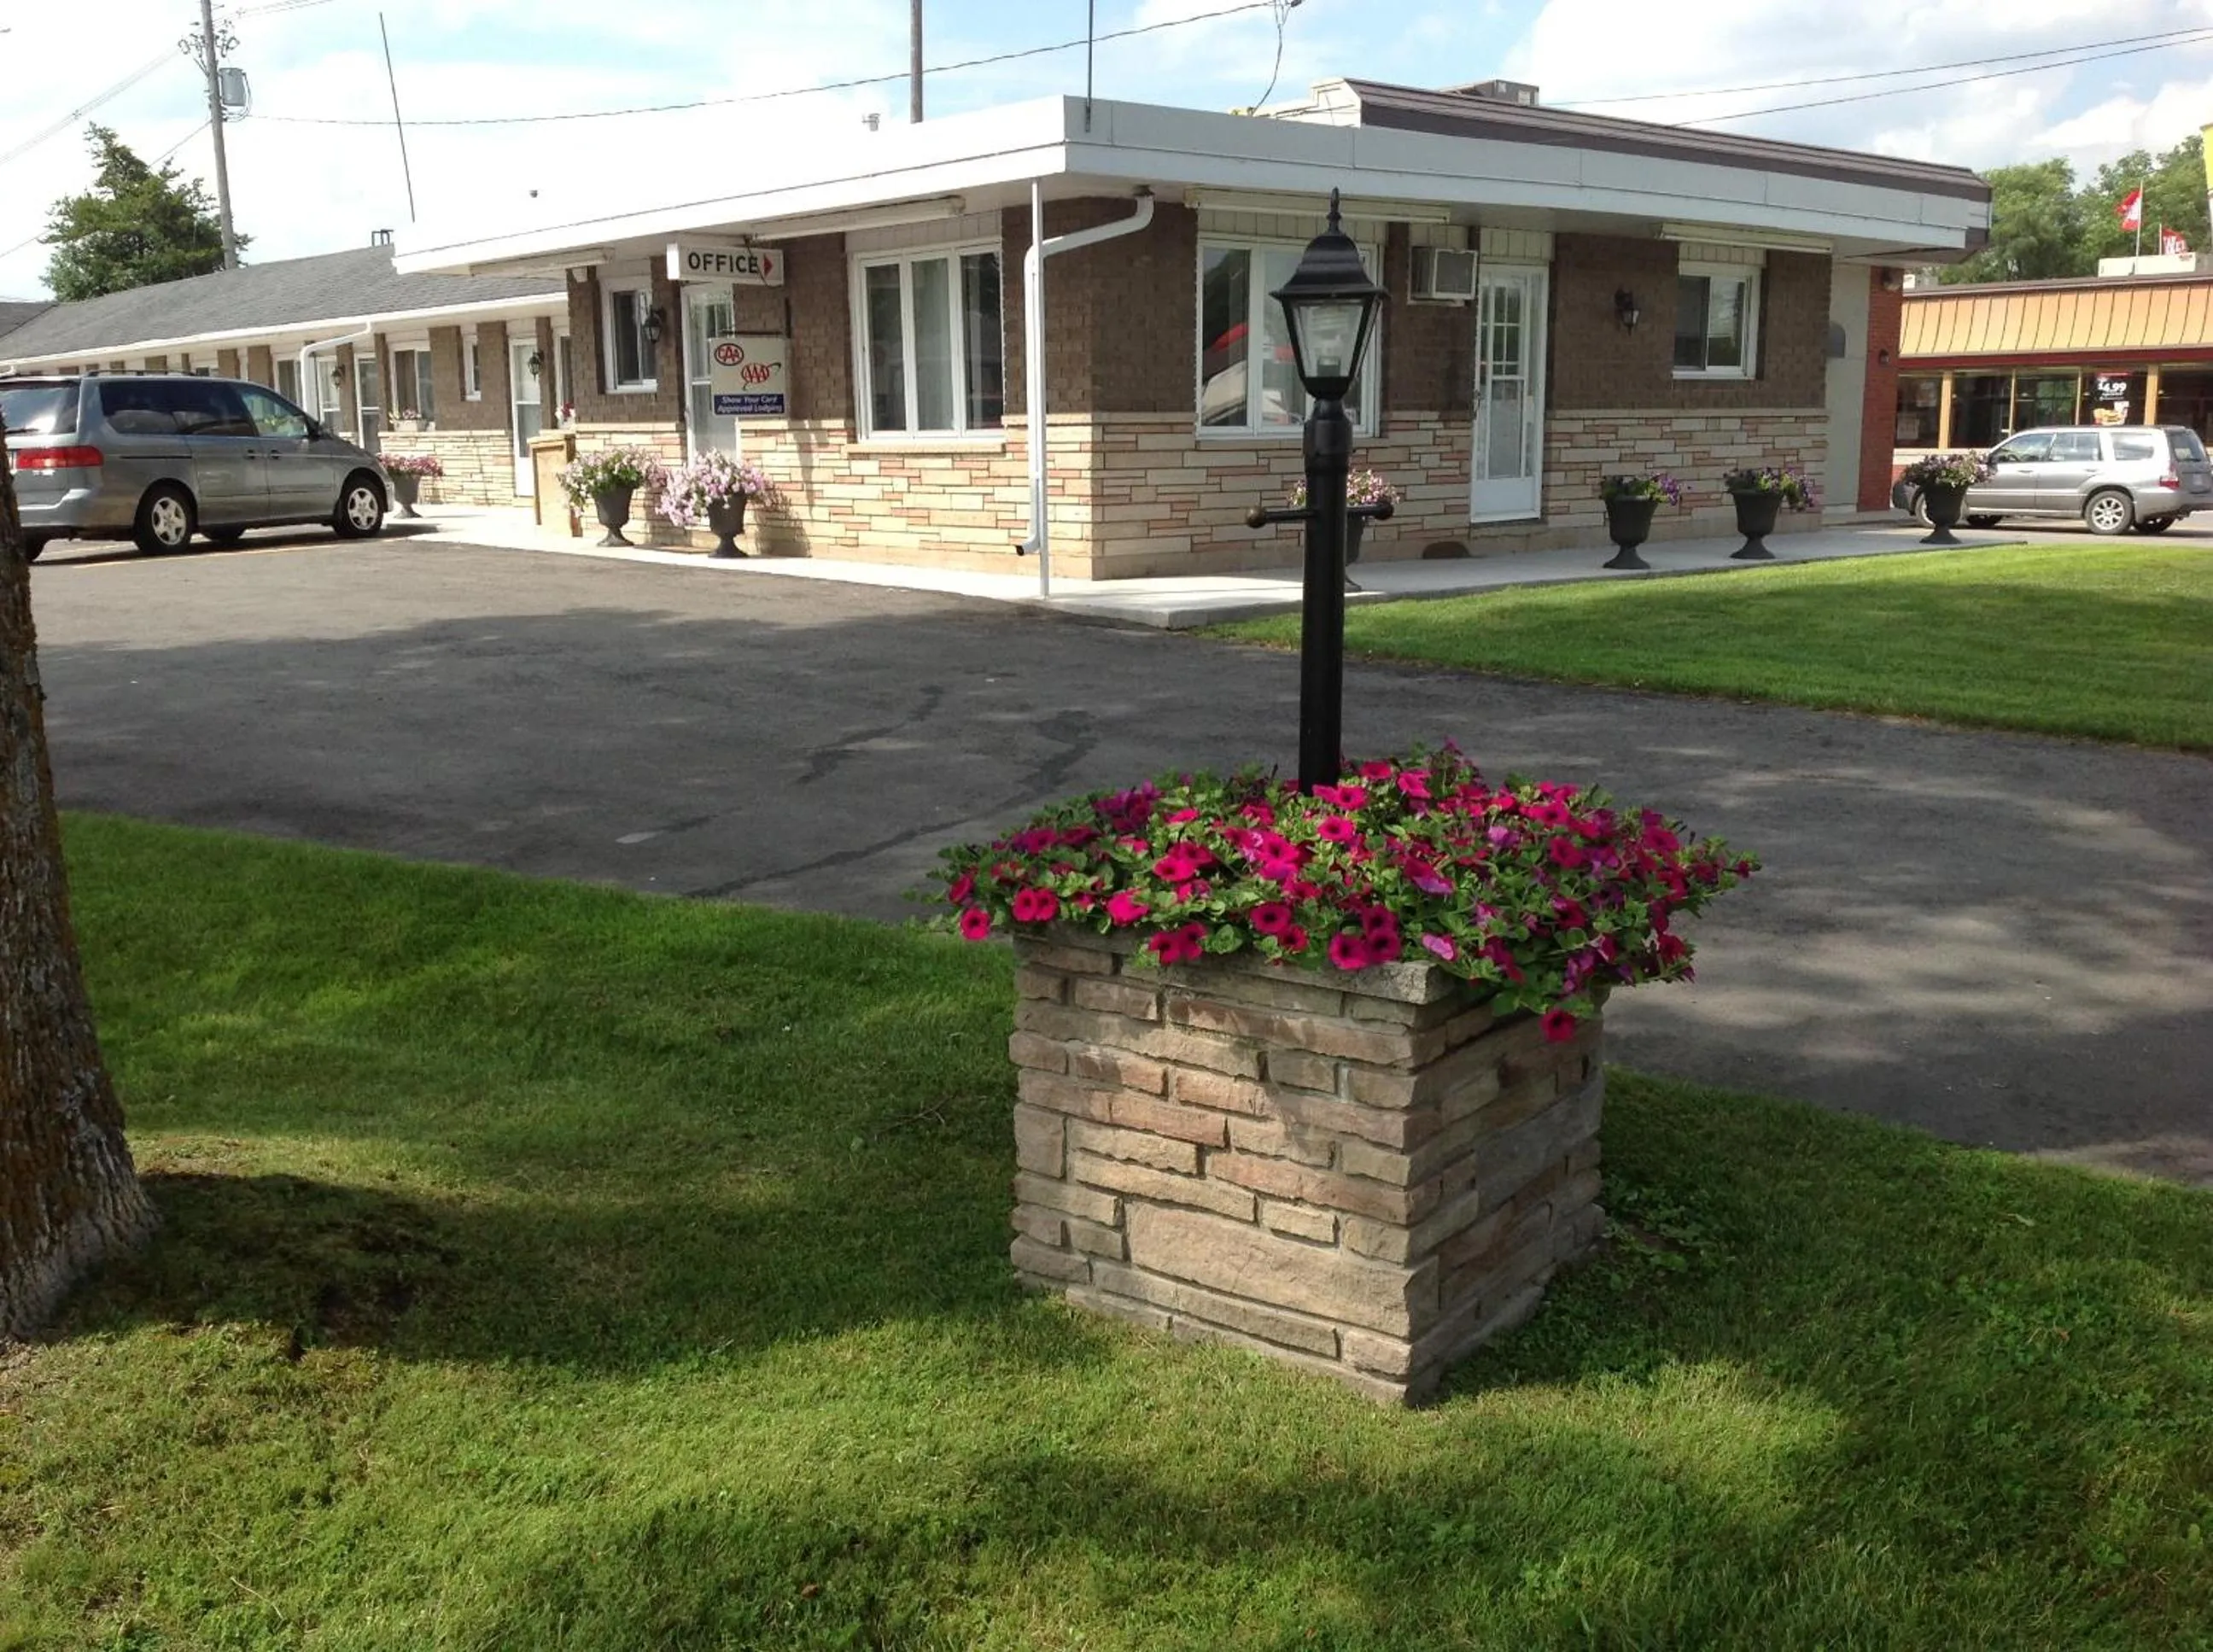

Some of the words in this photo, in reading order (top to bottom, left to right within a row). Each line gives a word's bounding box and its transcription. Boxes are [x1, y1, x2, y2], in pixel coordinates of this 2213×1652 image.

[688, 252, 758, 274] OFFICE
[717, 345, 741, 363] CAA
[744, 363, 769, 383] AAA
